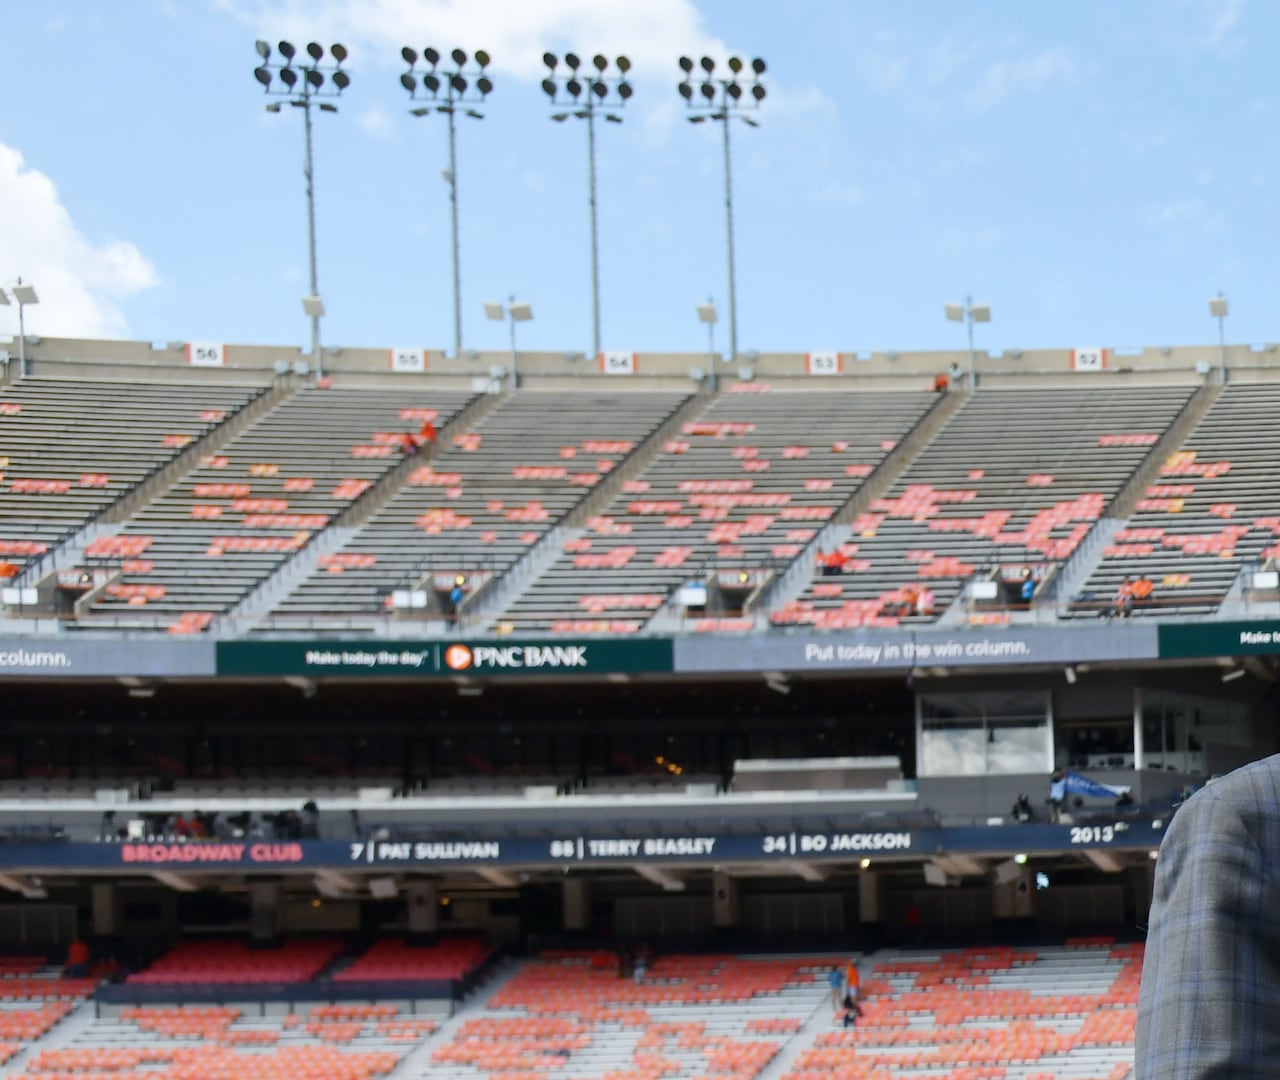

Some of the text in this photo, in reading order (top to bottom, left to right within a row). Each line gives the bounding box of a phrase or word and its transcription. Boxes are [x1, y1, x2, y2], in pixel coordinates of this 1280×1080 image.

[1240, 632, 1271, 644] Make
[305, 651, 341, 665] Make
[342, 650, 377, 667] today
[378, 650, 399, 665] the
[473, 645, 588, 668] PNC BANK
[805, 638, 1031, 664] Put today in the win column.
[763, 832, 912, 853] 34 BO JACKSON
[1070, 826, 1114, 843] 2013
[121, 842, 303, 862] BROADWAY CLUB
[379, 843, 411, 860] PAT
[414, 841, 500, 859] SULLIVAN
[589, 838, 641, 857] TERRY
[644, 836, 716, 855] BEASLEY
